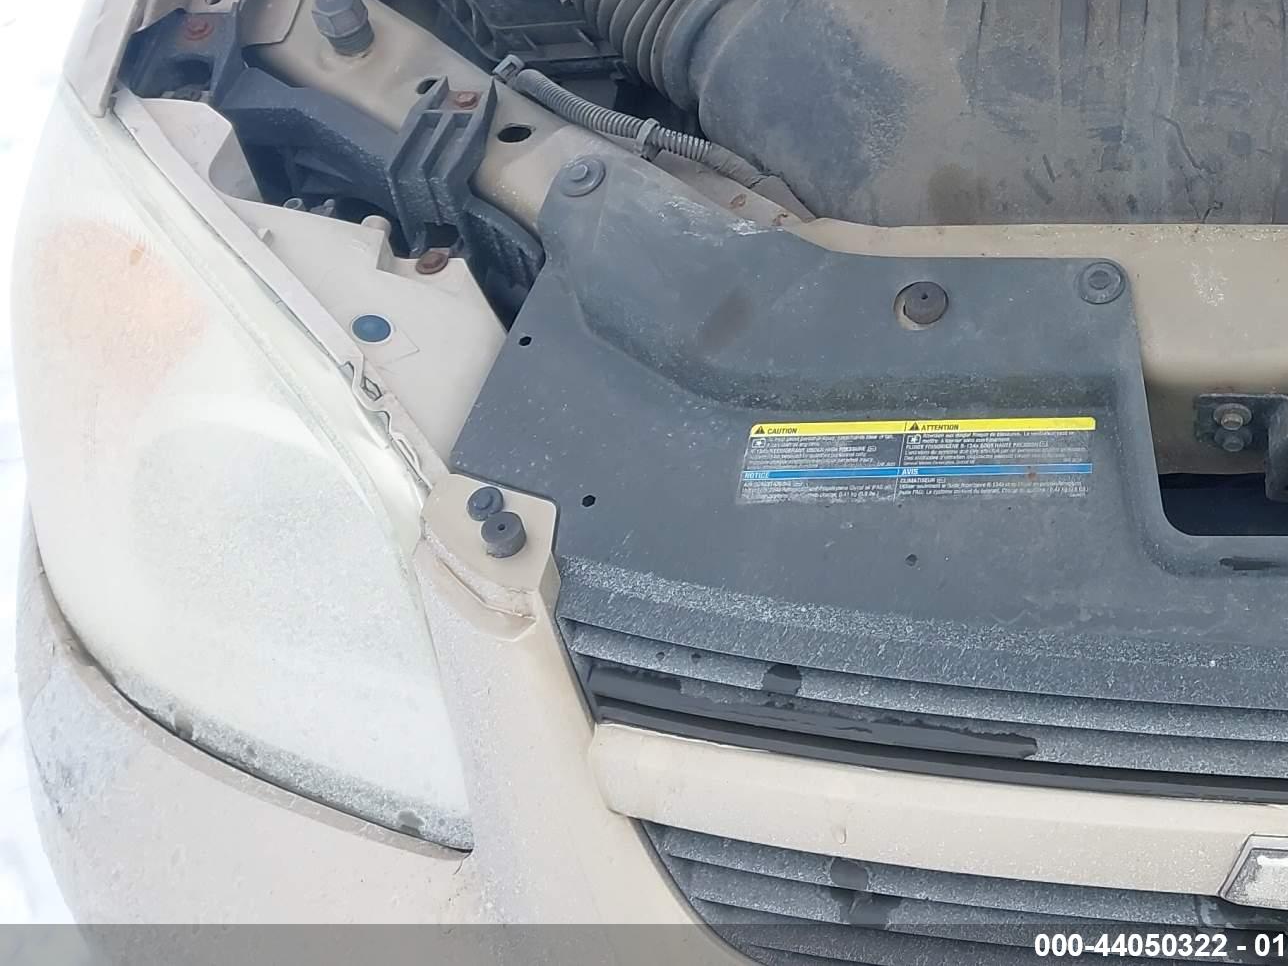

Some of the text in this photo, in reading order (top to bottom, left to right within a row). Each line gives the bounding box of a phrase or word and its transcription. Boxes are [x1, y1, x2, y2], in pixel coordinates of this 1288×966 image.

[767, 426, 798, 435] CAUTION
[921, 424, 960, 432] ATTENTION
[902, 468, 919, 476] AVIS
